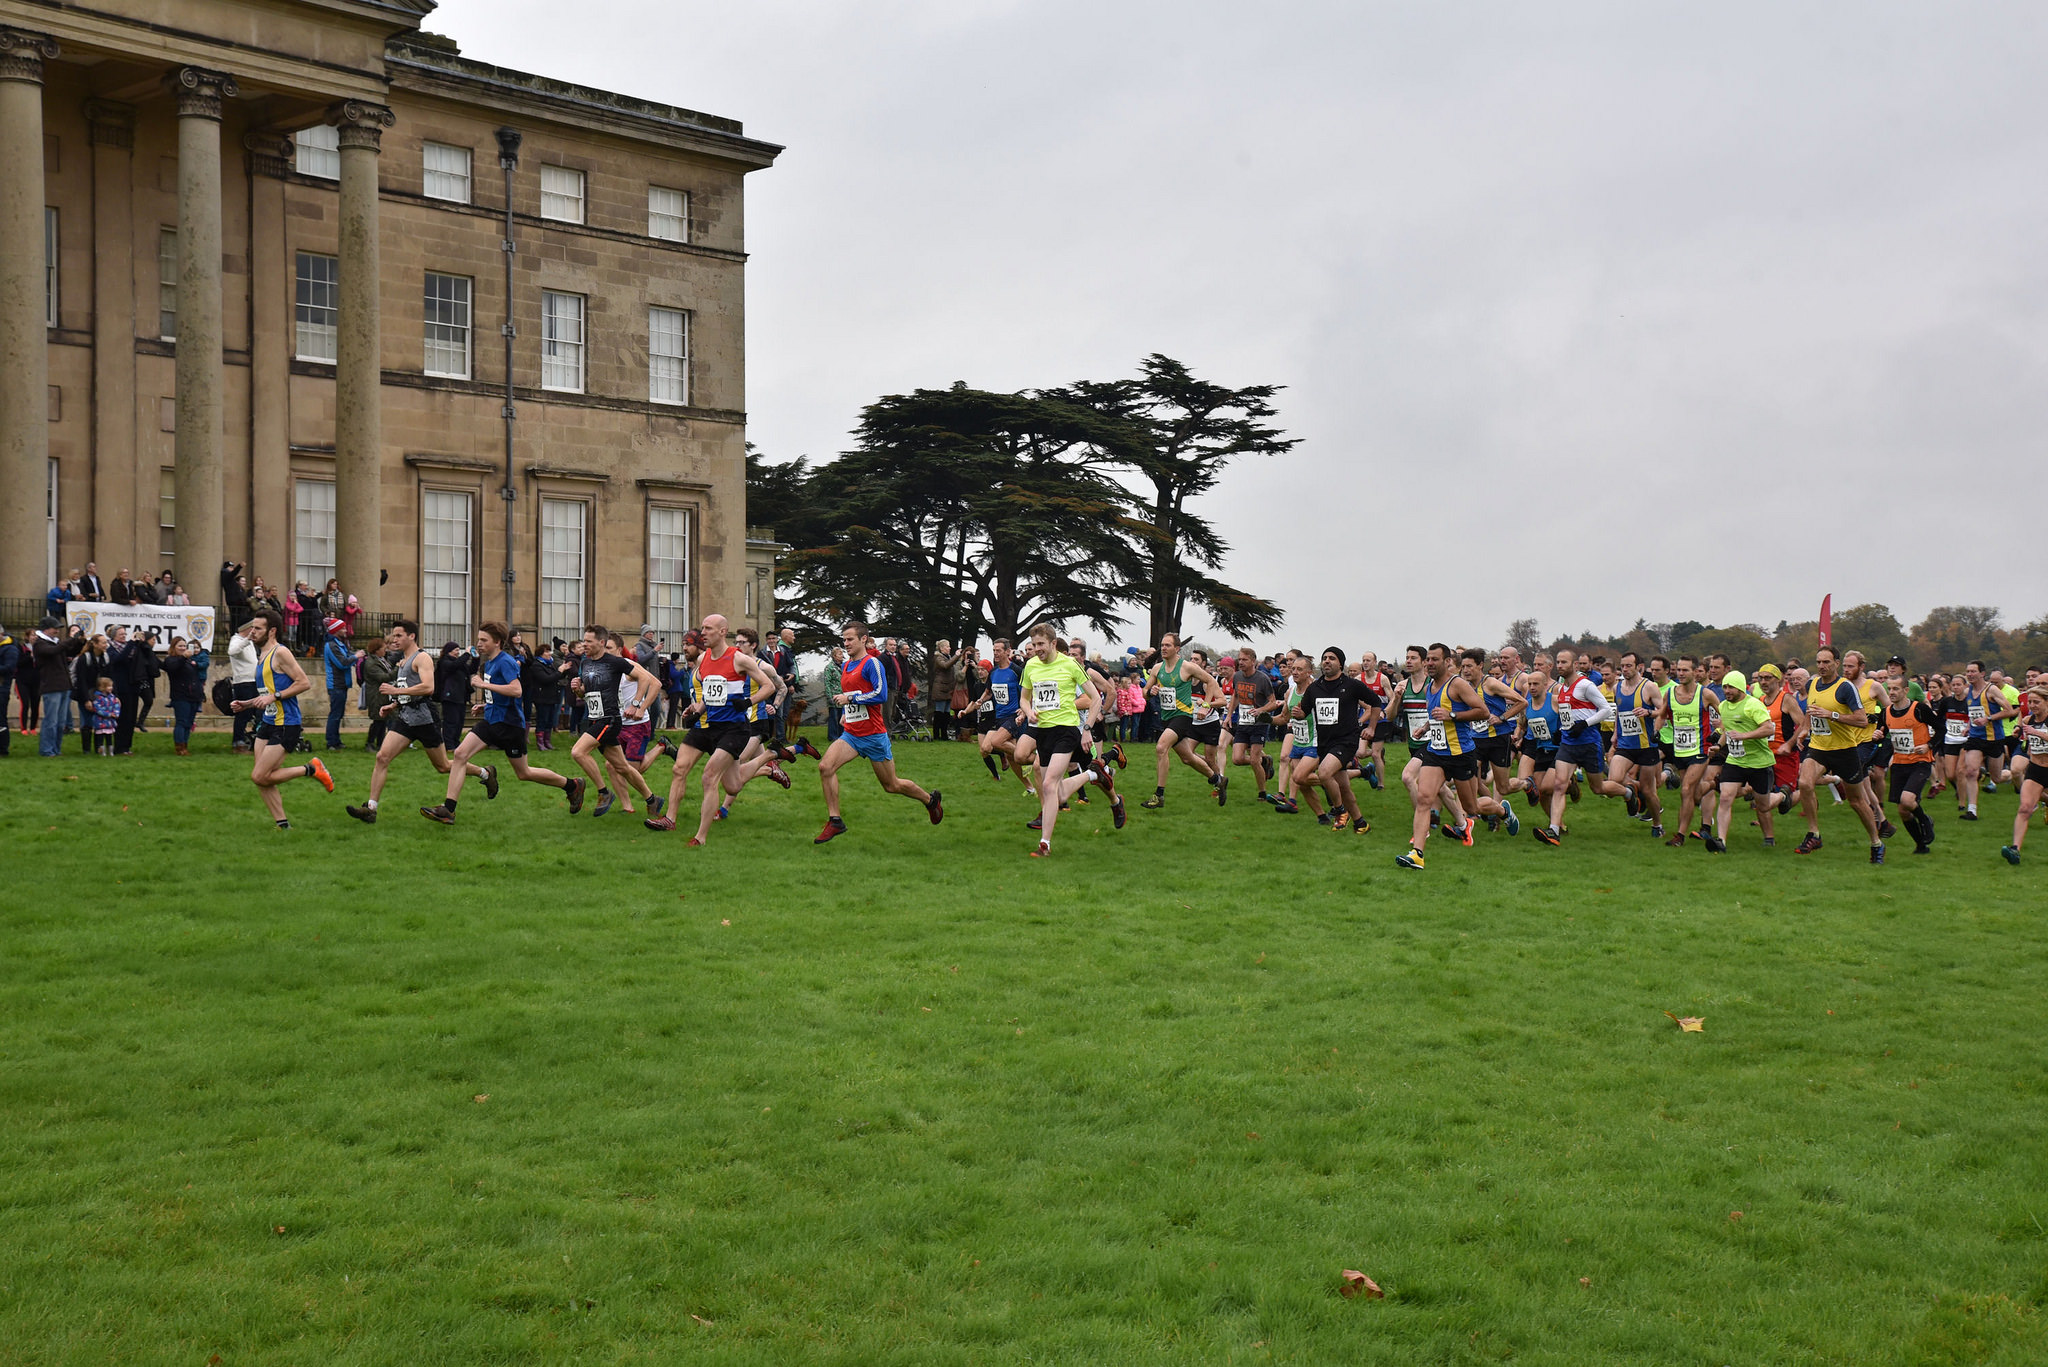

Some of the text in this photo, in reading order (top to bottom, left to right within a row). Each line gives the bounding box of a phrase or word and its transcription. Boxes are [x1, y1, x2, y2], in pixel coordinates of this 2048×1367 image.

[707, 685, 723, 697] 459
[1038, 689, 1056, 702] 422
[1319, 706, 1335, 717] 404
[1622, 719, 1638, 729] 426
[1677, 733, 1692, 744] 301
[1895, 737, 1910, 747] 142
